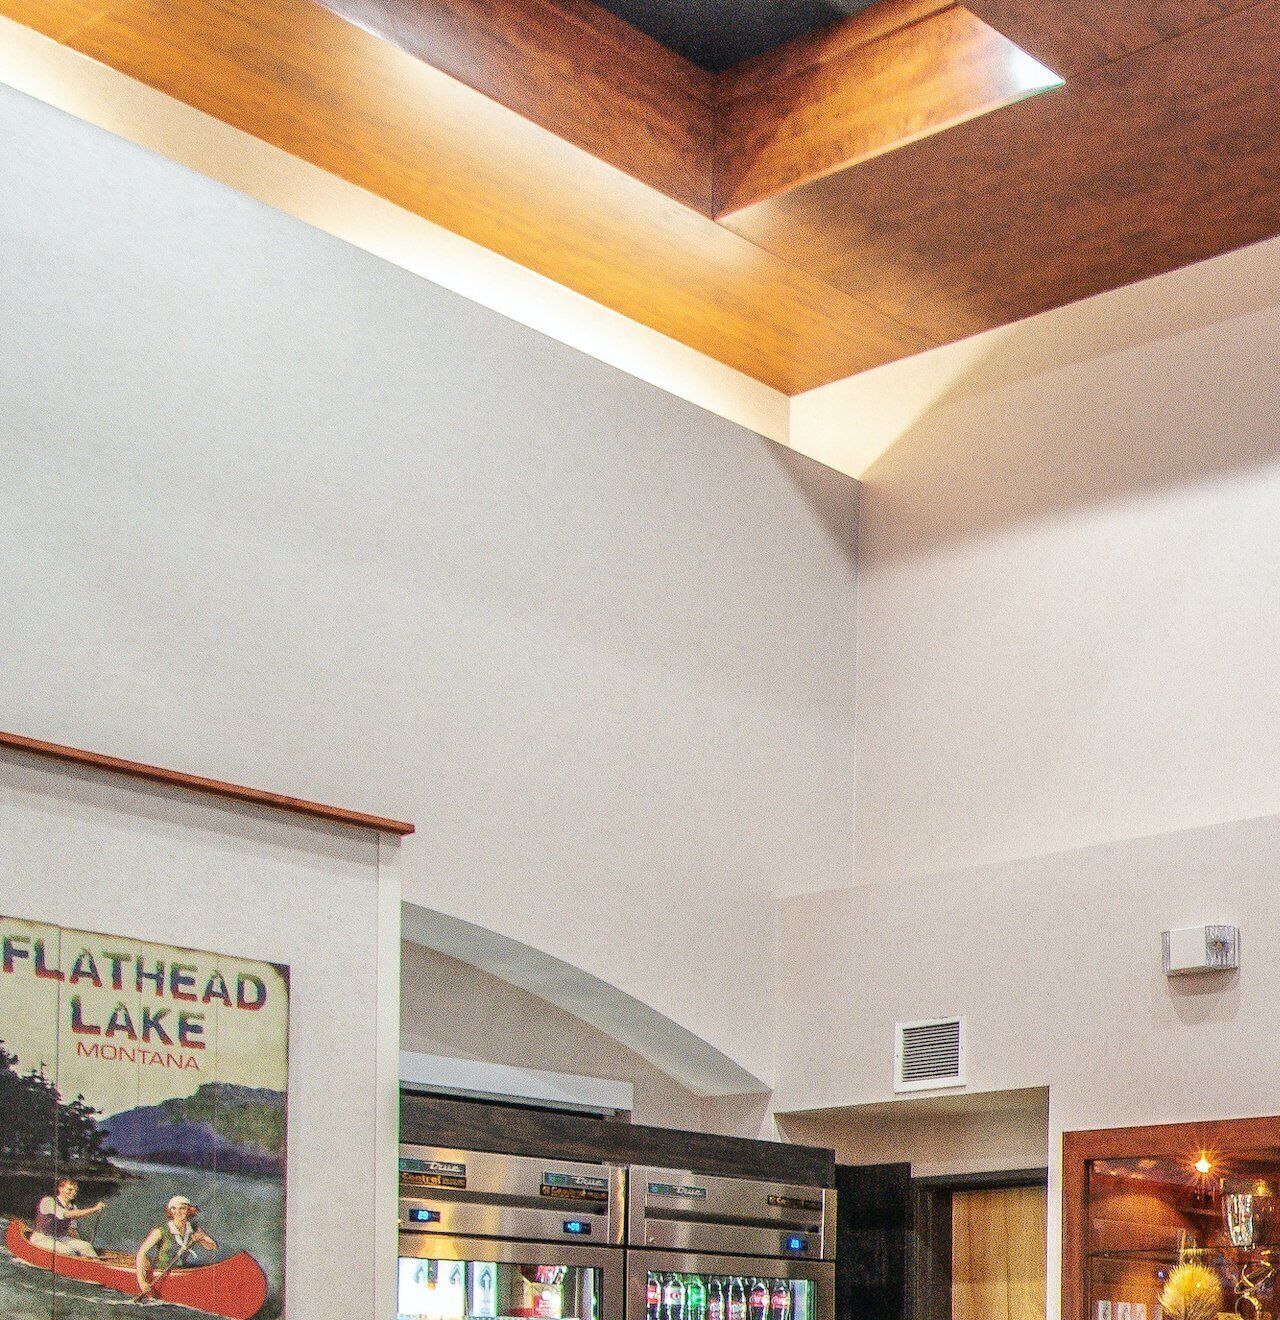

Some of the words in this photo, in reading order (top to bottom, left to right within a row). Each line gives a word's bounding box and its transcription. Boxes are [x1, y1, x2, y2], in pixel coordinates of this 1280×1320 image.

[1, 935, 267, 1011] FLATHEAD
[70, 994, 206, 1050] LAKE
[77, 1041, 200, 1072] MONTANA
